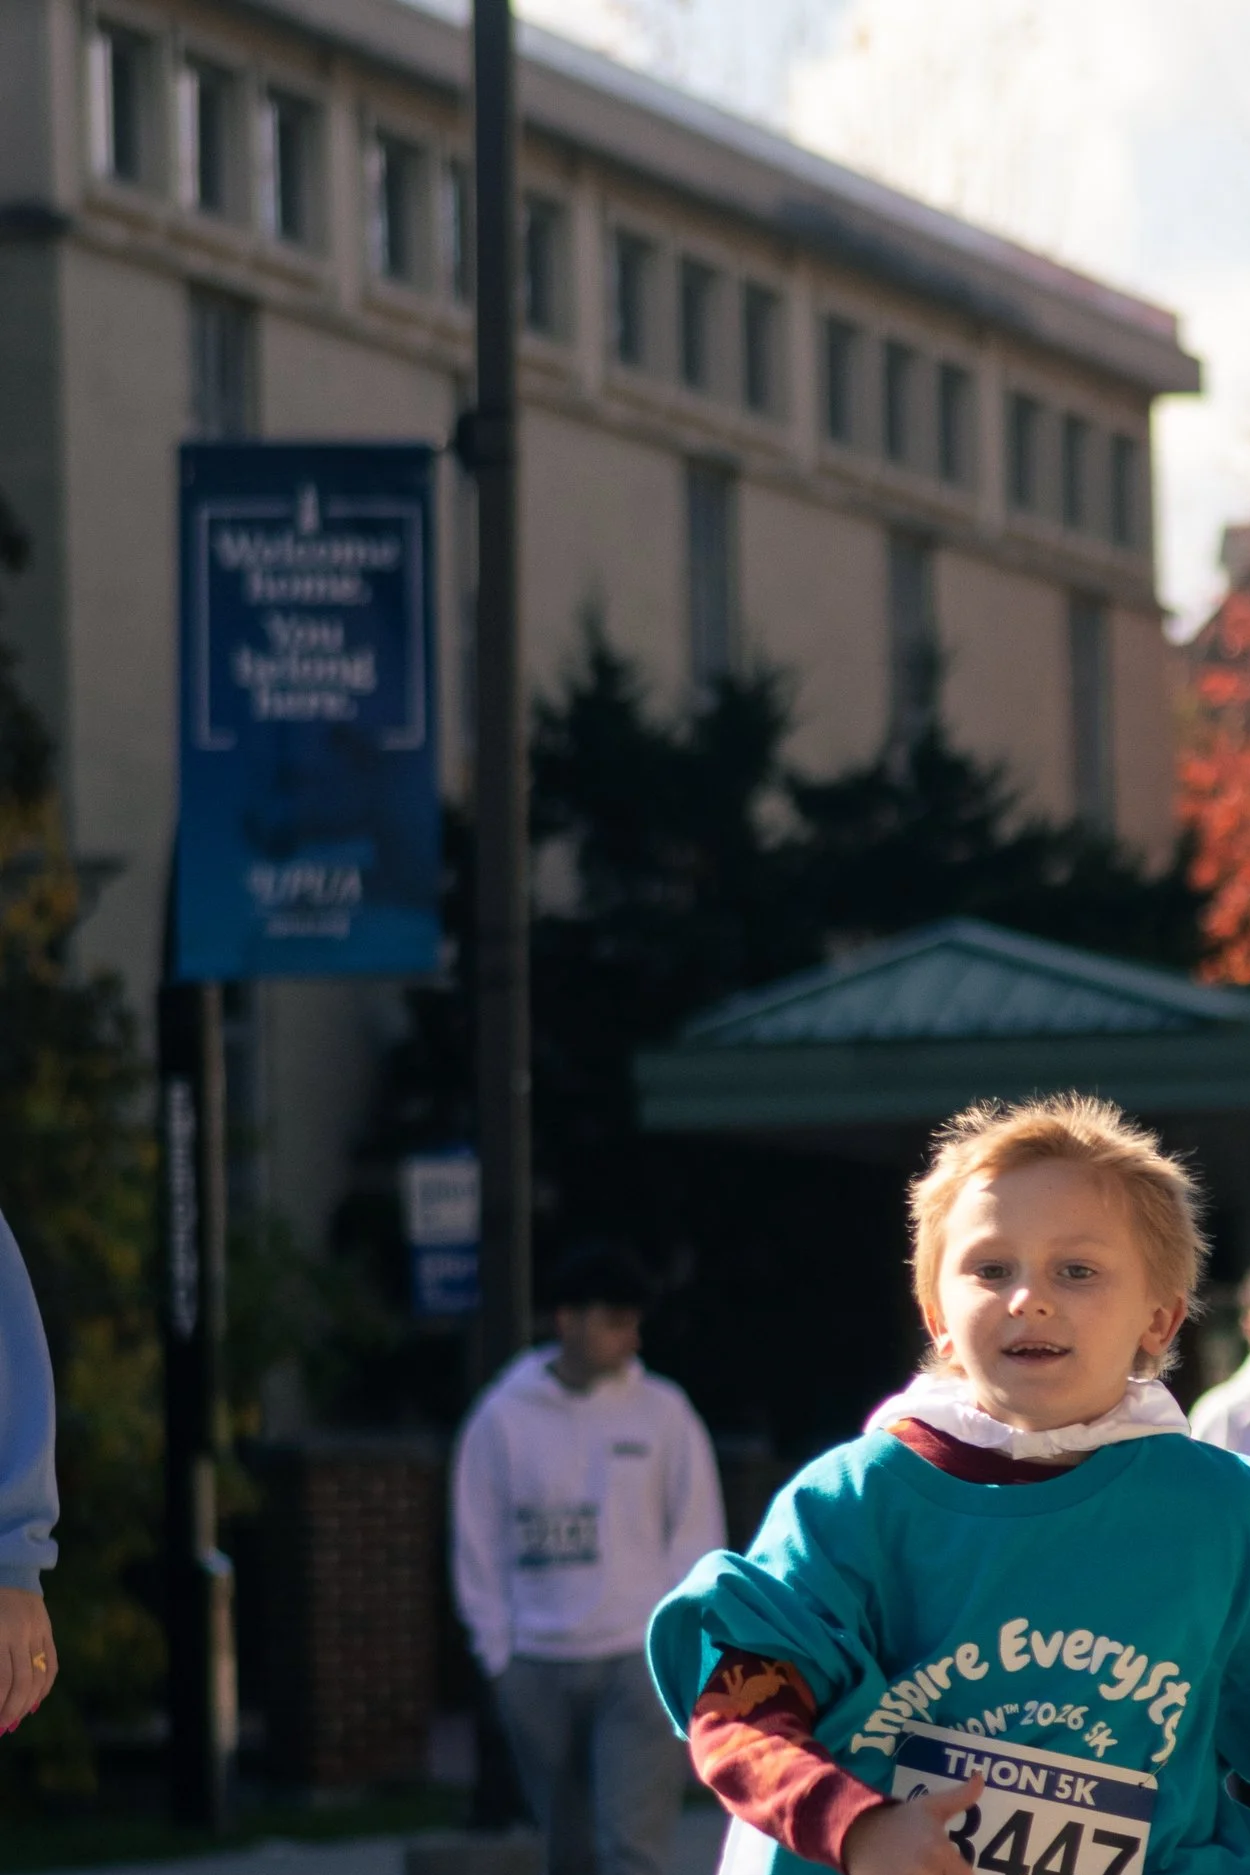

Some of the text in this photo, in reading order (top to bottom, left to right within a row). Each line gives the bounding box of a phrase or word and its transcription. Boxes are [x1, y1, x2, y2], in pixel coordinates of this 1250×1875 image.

[850, 1642, 990, 1757] Inspire
[1019, 1700, 1090, 1731] 2026
[1084, 1721, 1118, 1758] 5K
[1054, 1773, 1100, 1806] 5K
